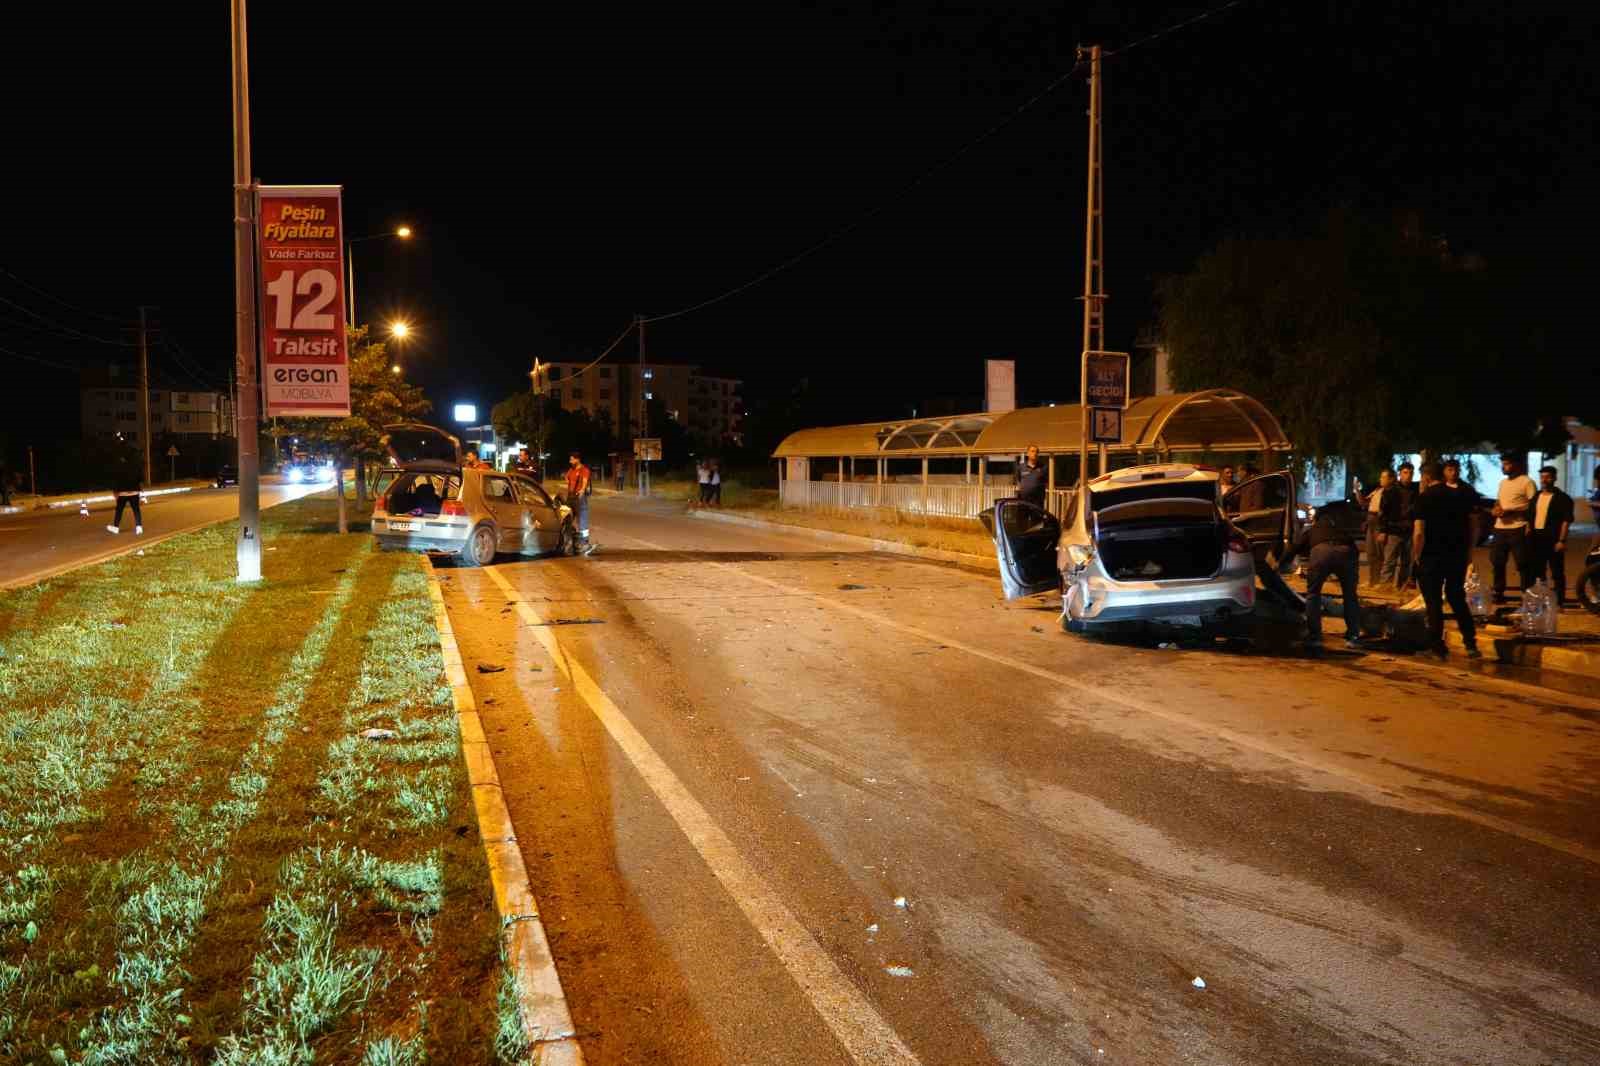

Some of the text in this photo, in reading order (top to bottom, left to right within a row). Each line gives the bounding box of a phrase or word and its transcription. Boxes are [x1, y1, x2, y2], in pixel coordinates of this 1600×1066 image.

[281, 204, 326, 223] Peşin
[264, 223, 336, 242] Fiyatlara
[269, 249, 296, 258] Vade
[266, 268, 337, 330] 12
[273, 338, 338, 356] Taksit
